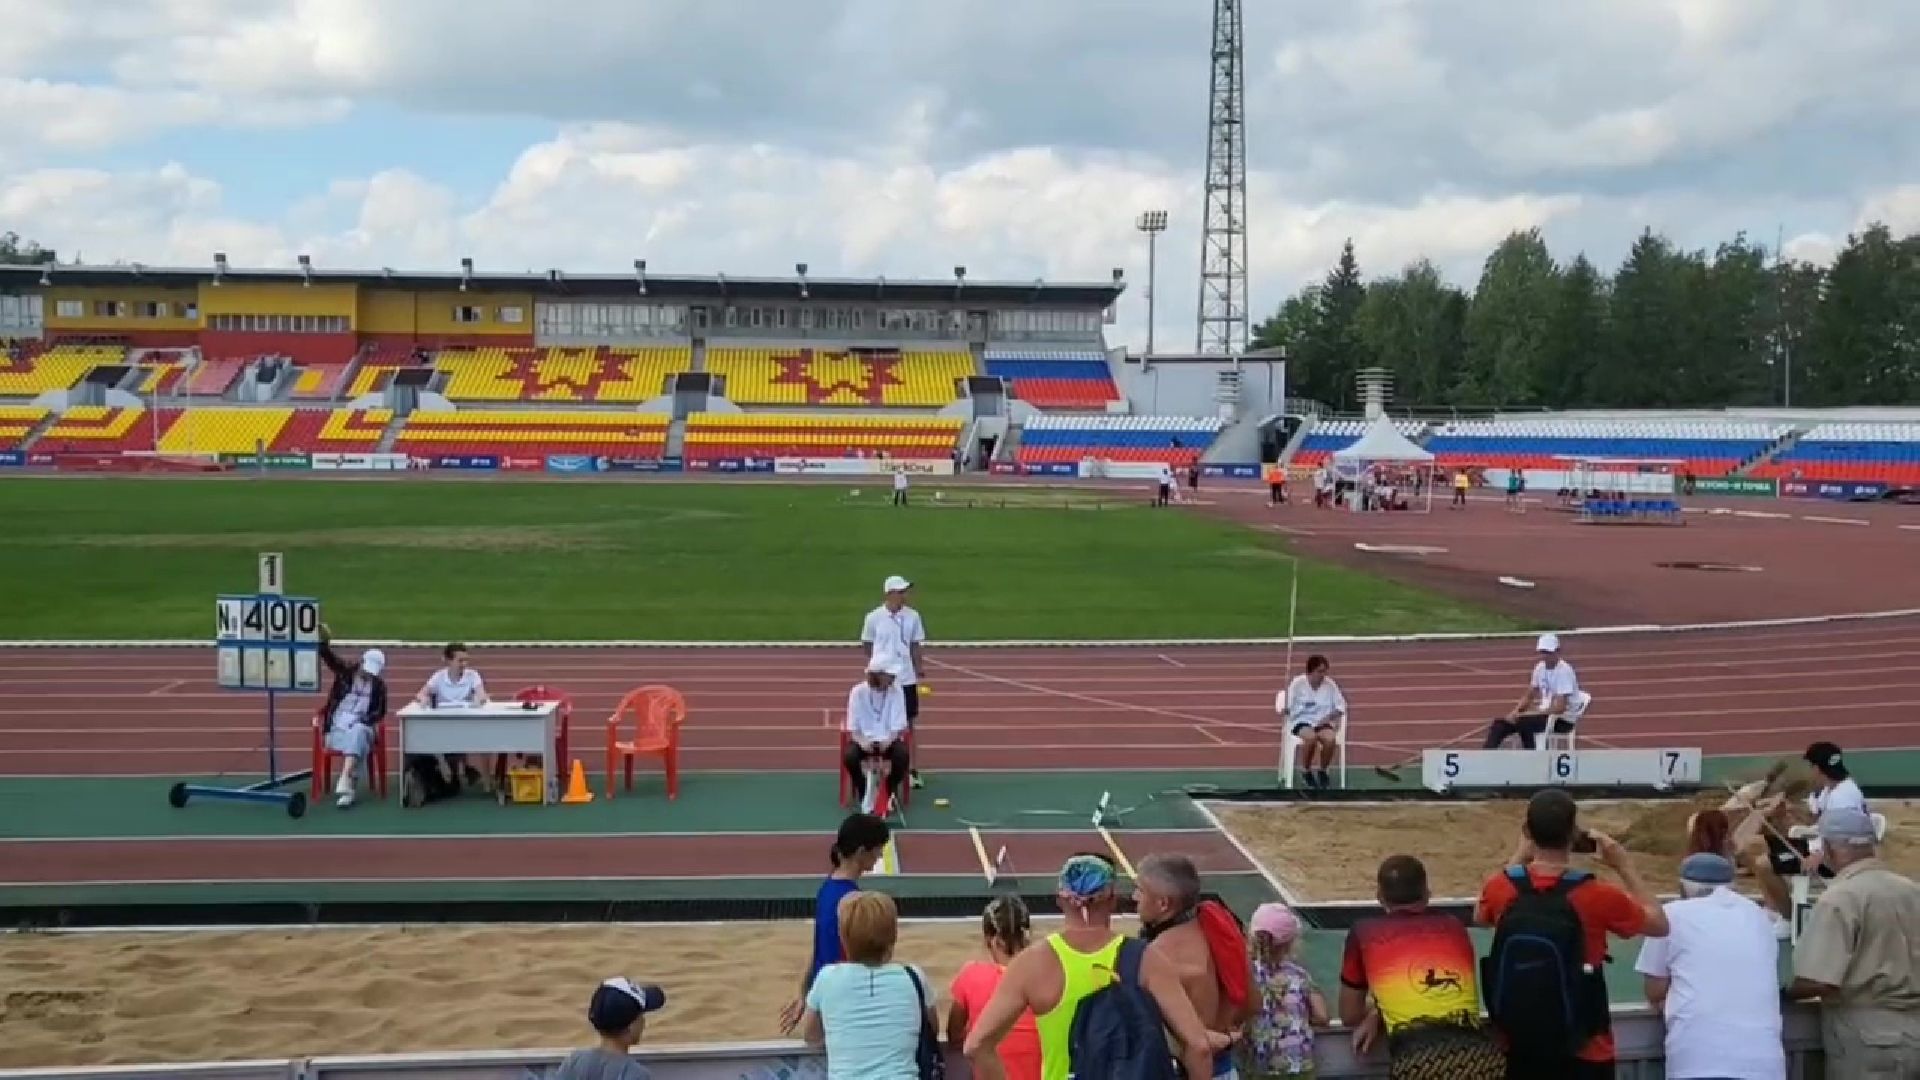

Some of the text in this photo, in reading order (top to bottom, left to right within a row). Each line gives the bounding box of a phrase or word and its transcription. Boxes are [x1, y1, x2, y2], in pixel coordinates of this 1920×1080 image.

[264, 555, 276, 586] 1
[1444, 752, 1680, 778] 5 6 7
